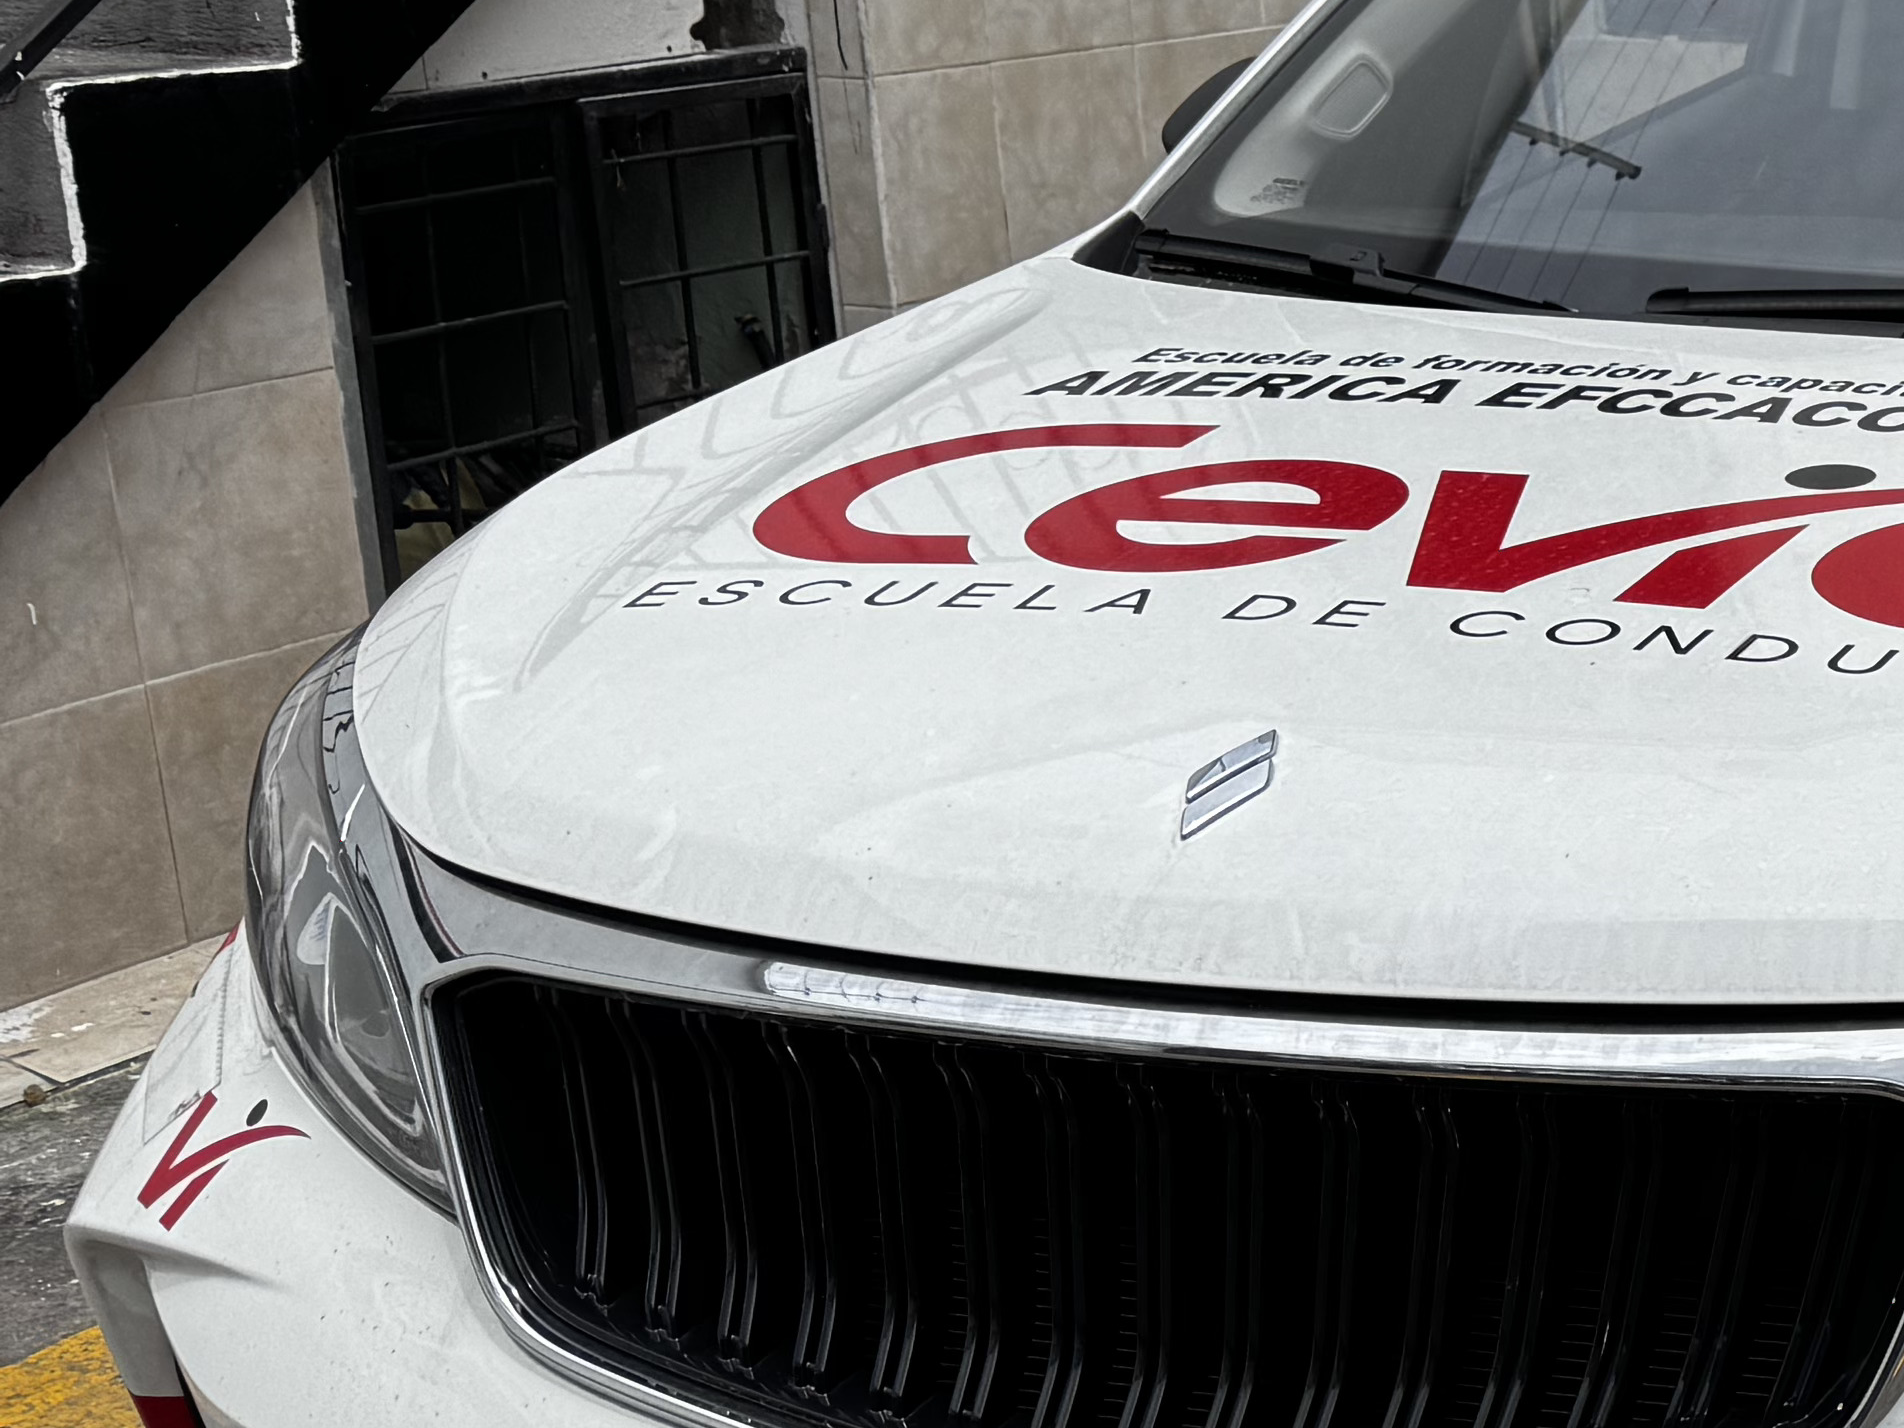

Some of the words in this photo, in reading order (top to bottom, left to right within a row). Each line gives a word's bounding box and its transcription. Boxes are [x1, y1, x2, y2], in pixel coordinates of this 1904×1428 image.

[1022, 370, 1464, 405] AMERICA
[1132, 346, 1331, 369] Escuela
[1339, 348, 1405, 371] de
[1417, 353, 1672, 384] formación
[1675, 371, 1724, 389] y
[621, 579, 1152, 617] ESCUELA
[1221, 593, 1388, 630] DE
